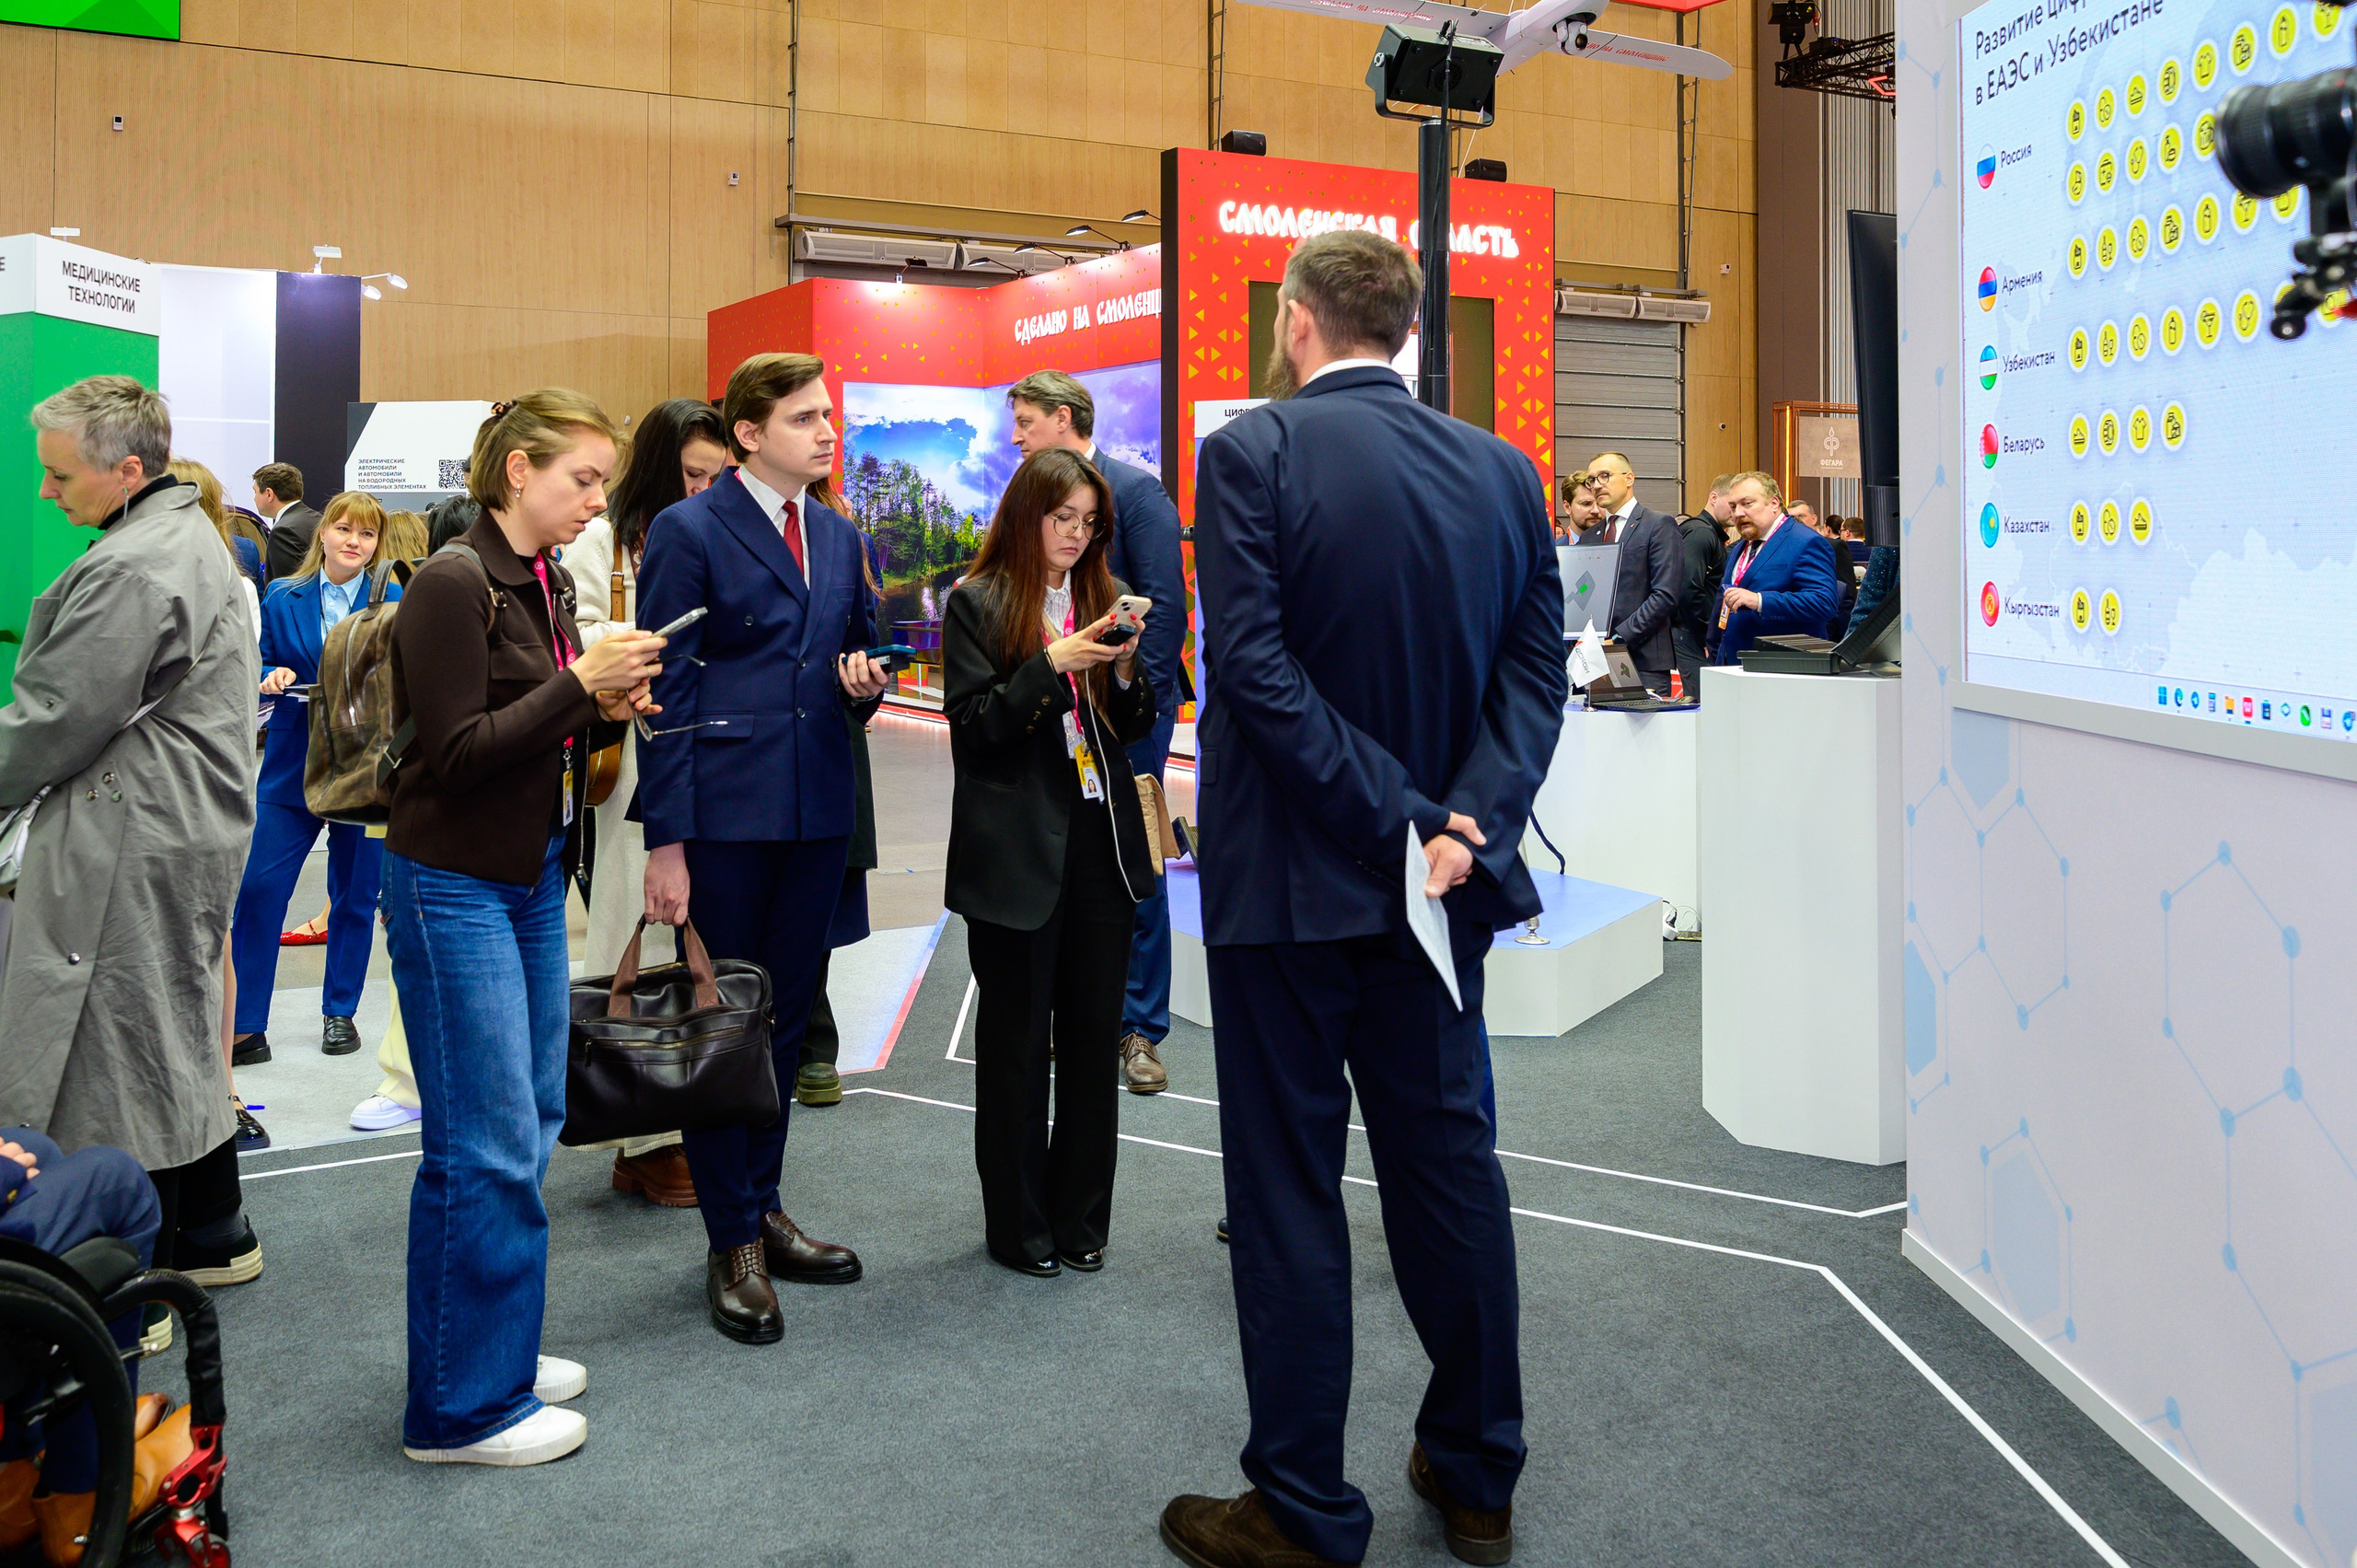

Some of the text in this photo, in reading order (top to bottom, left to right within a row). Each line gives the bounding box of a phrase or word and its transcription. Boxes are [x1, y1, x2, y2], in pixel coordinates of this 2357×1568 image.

[1975, 5, 2043, 60] Развитие
[1975, 0, 2163, 106] в ЕАЭС и Узбекистане
[2000, 144, 2032, 168] Россия
[62, 260, 141, 294] МЕДИЦИНСКИЕ
[2002, 270, 2043, 296] Армения
[68, 285, 135, 314] ТЕХНОЛОГИИ
[1014, 308, 1068, 346] СДЕЛАНО
[1073, 304, 1090, 331] НА
[2003, 349, 2056, 374] Узбекистан
[2003, 436, 2045, 457] Беларусь
[1819, 459, 1844, 467] ФЕГАРА
[2003, 516, 2049, 534] Казахстан
[2004, 597, 2060, 621] Кыргызстан
